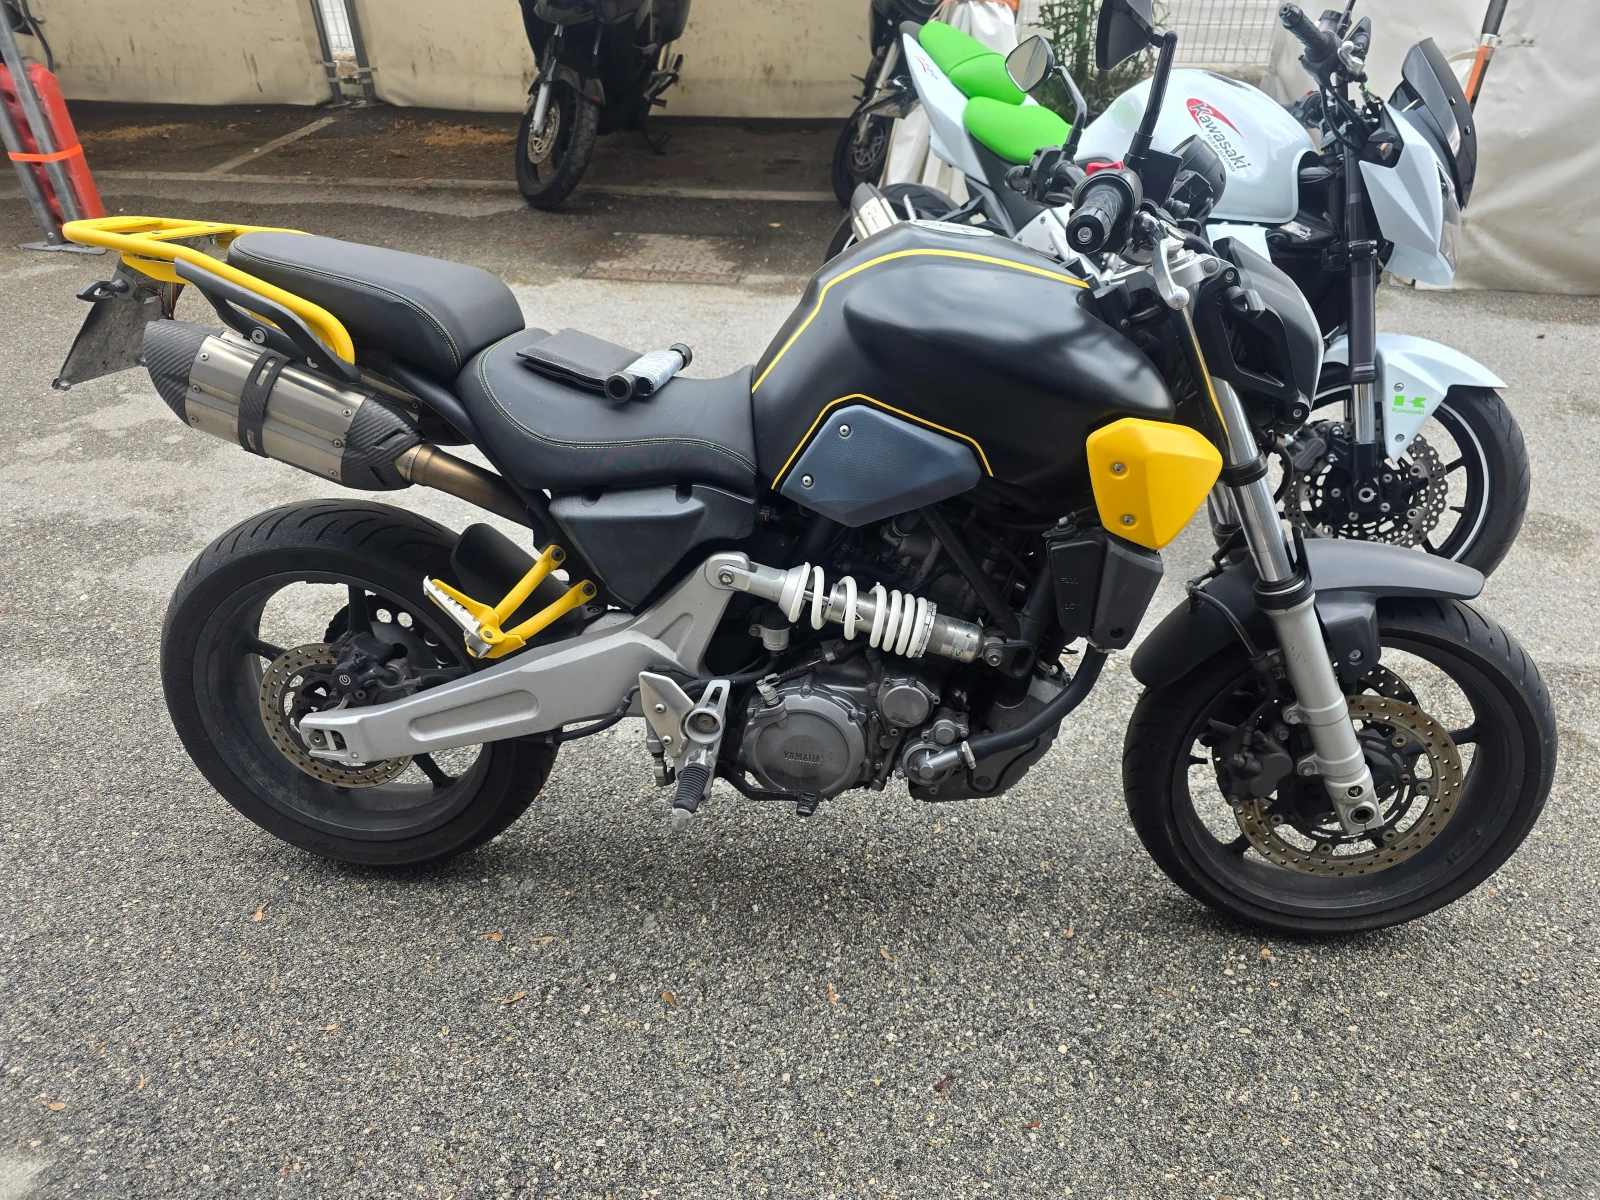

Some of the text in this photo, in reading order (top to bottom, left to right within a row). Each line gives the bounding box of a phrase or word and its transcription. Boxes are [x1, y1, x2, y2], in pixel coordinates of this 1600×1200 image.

[1191, 103, 1251, 169] Kawasaki
[1205, 133, 1236, 172] TEAM RACING
[1391, 407, 1425, 415] Kawasaki
[784, 751, 820, 764] YAMAHA
